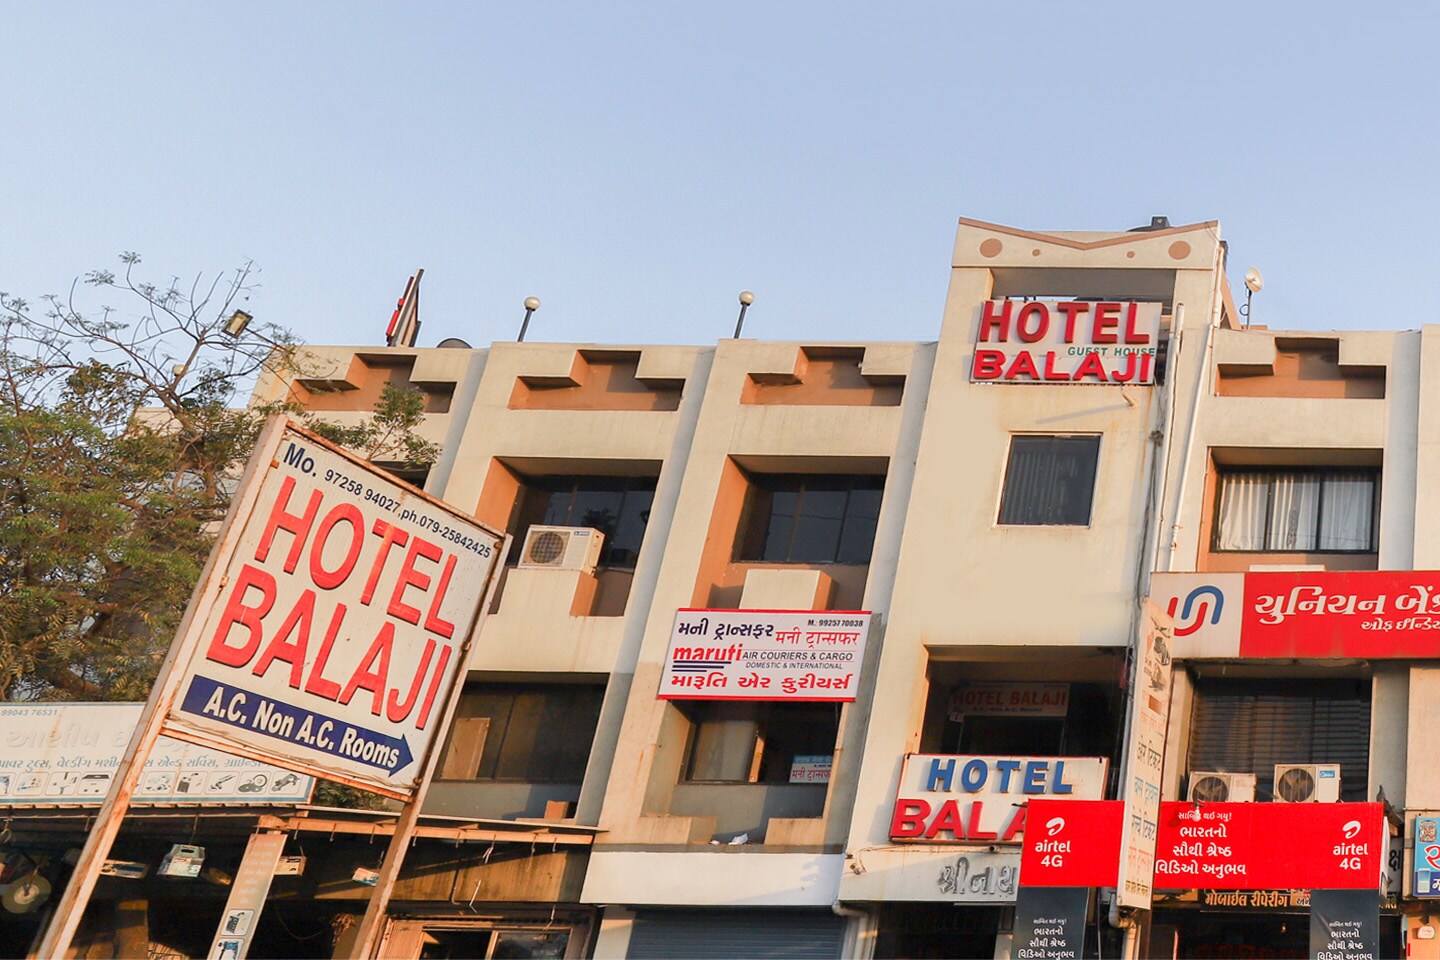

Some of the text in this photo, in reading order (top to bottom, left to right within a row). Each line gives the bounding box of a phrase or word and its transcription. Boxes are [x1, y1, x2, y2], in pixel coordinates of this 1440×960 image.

[979, 300, 1150, 344] HOTEL
[1068, 347, 1108, 356] GUEST
[973, 350, 1151, 382] BALAJI
[283, 442, 317, 477] Mo.
[324, 469, 363, 496] 97258
[254, 475, 457, 639] HOTEL
[1255, 585, 1387, 625] યુનિયન
[678, 617, 774, 640] મની ટ્રાન્સફર
[775, 627, 801, 645] मनी
[206, 564, 452, 730] BALAJI
[672, 643, 743, 661] maruti
[743, 651, 853, 660] AIR COURIERS & CARGO
[738, 672, 771, 688] એર
[203, 687, 400, 769] A.C. Non A.C. Rooms
[927, 758, 1072, 794] HOTEL
[890, 799, 1028, 840] BALA
[1180, 823, 1227, 838] ભારતનો
[1035, 840, 1071, 853] airtel
[1172, 842, 1203, 857] સૌથી
[1333, 842, 1369, 856] airtel
[1040, 855, 1063, 868] 4G
[1155, 860, 1247, 879] વિડિઓ અનુભવ
[1339, 857, 1362, 870] 4G
[1033, 925, 1064, 937] ભારતનો
[1330, 928, 1360, 939] ભારતનો
[1029, 936, 1048, 948] સૌથી
[1327, 940, 1346, 950] સૌથી
